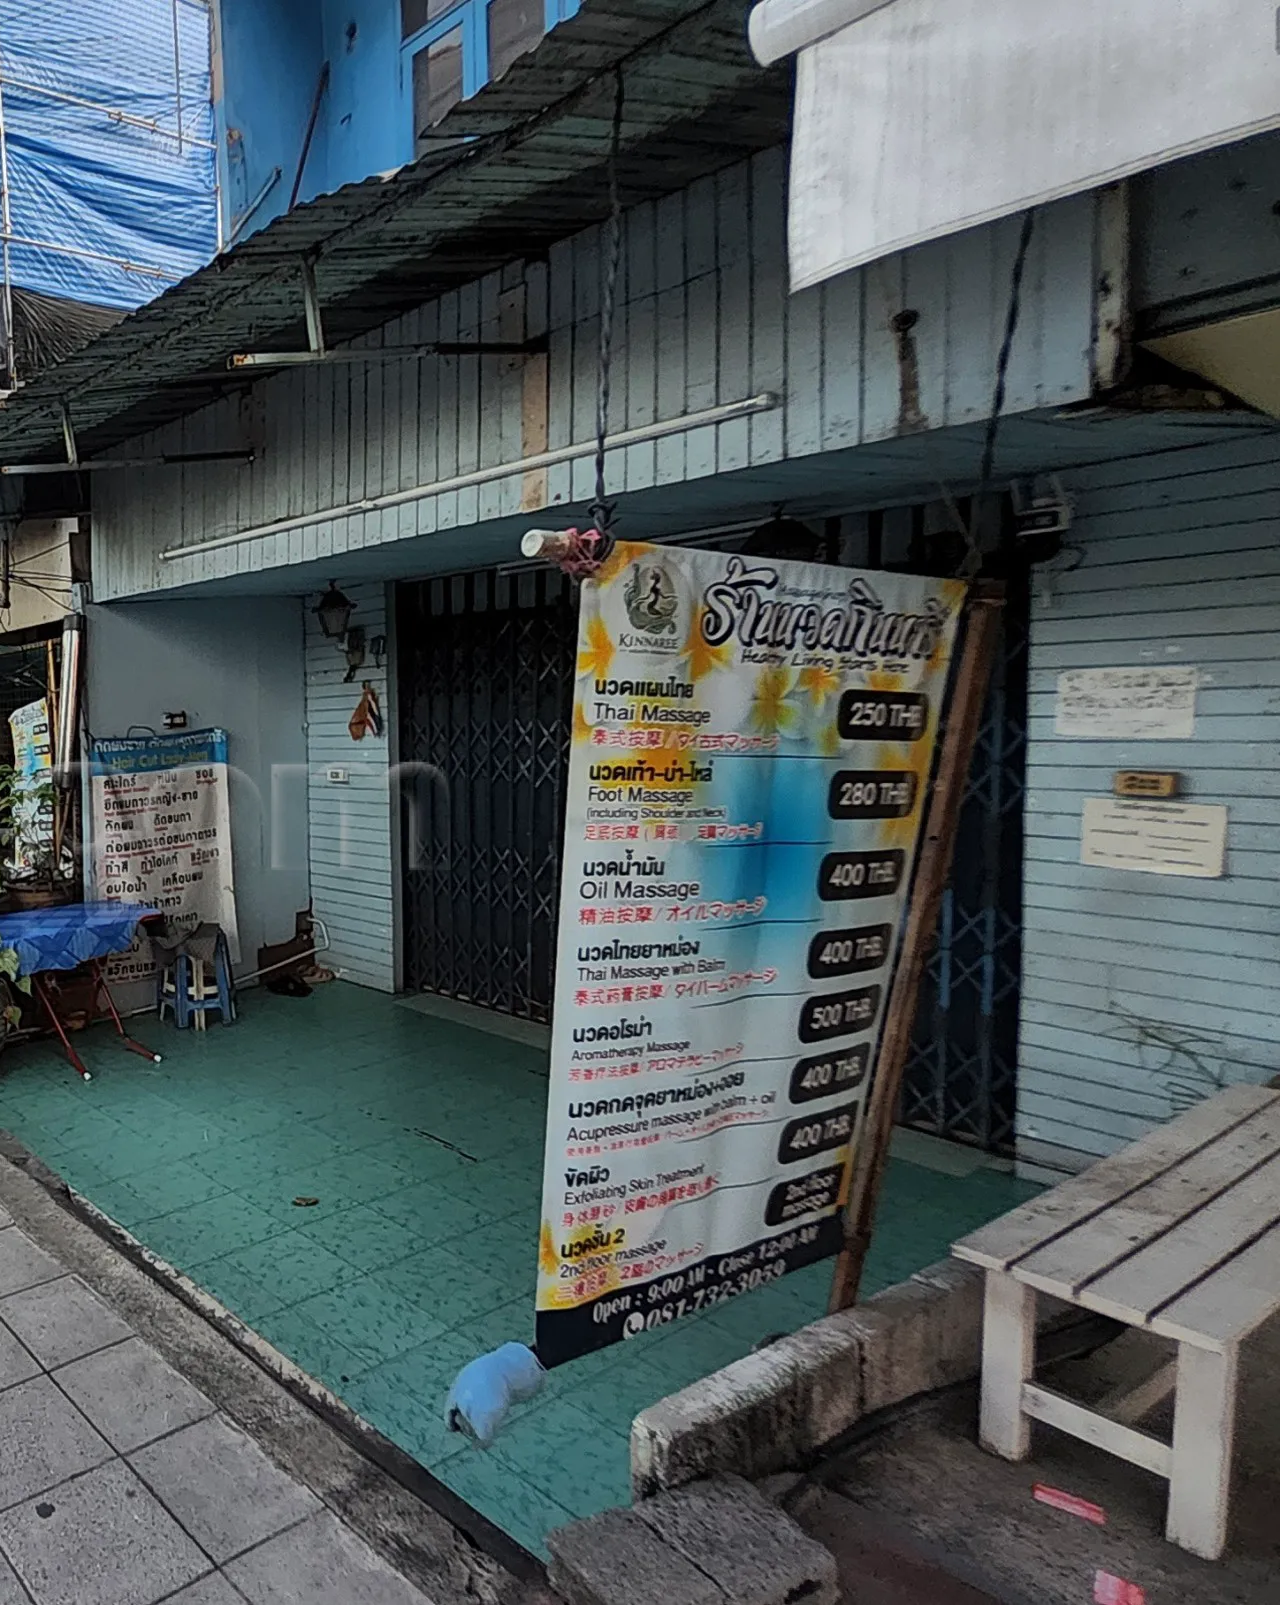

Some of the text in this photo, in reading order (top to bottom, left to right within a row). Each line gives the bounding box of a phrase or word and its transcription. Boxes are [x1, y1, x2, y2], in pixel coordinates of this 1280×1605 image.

[594, 676, 695, 699] นวดแผนไทย
[594, 703, 711, 727] Thai Massage
[849, 702, 887, 727] 250
[588, 786, 693, 806] Foot Massage
[839, 782, 877, 806] 280
[583, 849, 665, 877] นวดน้ำมัน
[828, 864, 865, 887] 400
[579, 881, 700, 901] Oil Massage
[819, 941, 852, 965] 400
[578, 967, 606, 982] Thai
[611, 965, 669, 981] Massage
[573, 1015, 652, 1043] นวดอโรม่า
[809, 1004, 842, 1030] 500
[571, 1040, 691, 1062] Aromatherapy Massage
[800, 1064, 832, 1089] 400
[566, 1119, 649, 1143] Acupressure
[650, 1108, 703, 1126] massage
[789, 1124, 821, 1149] 400
[564, 1165, 610, 1187] ขัดผิว
[564, 1183, 627, 1205] Exfoliating
[614, 1228, 626, 1245] 2
[593, 1296, 632, 1323] Open
